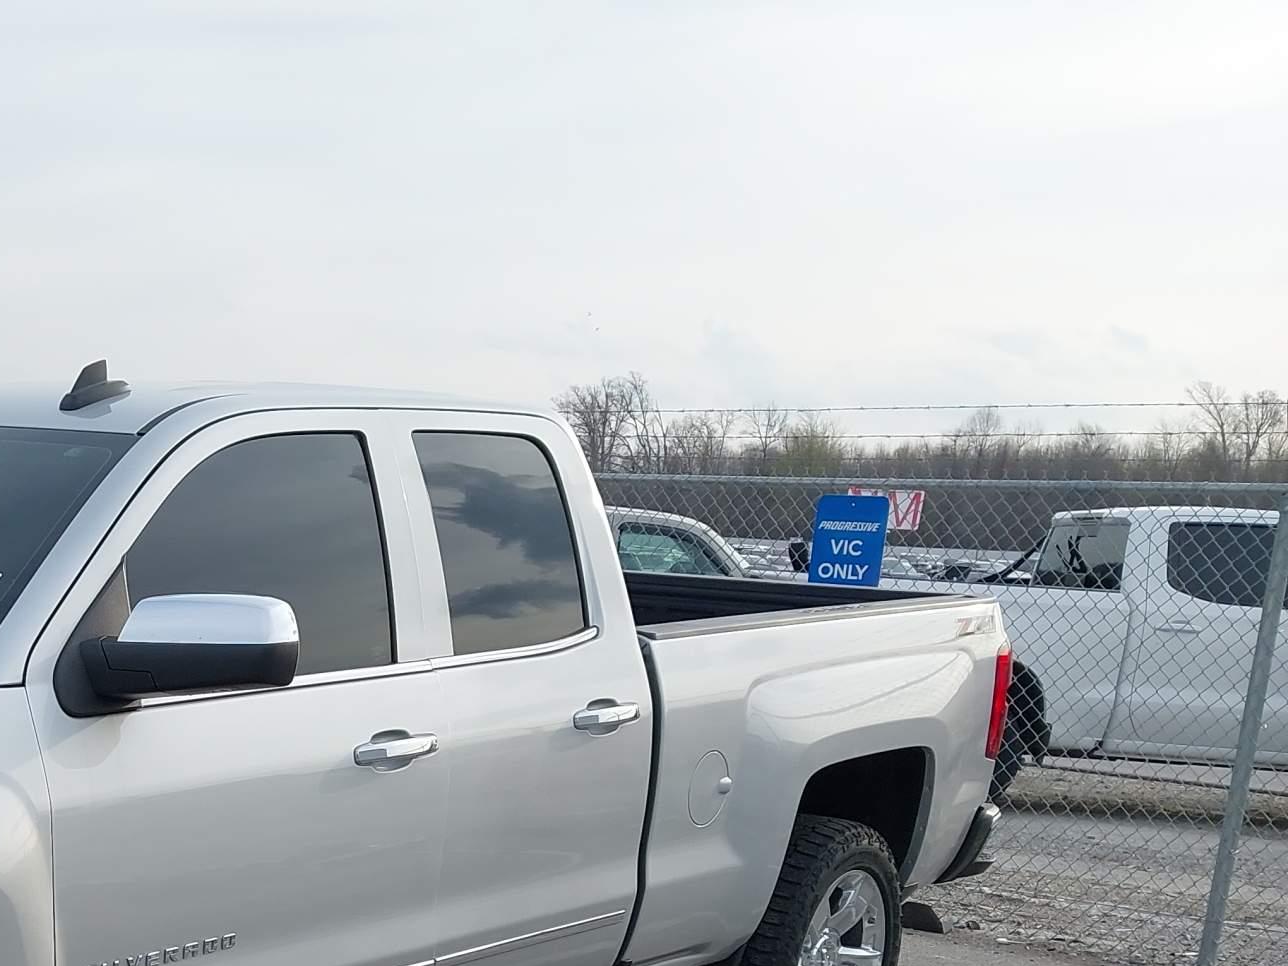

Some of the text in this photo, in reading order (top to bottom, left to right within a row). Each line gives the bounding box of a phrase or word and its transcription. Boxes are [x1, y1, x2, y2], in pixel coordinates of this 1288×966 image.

[818, 520, 881, 533] PROGRESSIVE
[830, 538, 864, 556] VIC
[817, 562, 869, 580] ONLY
